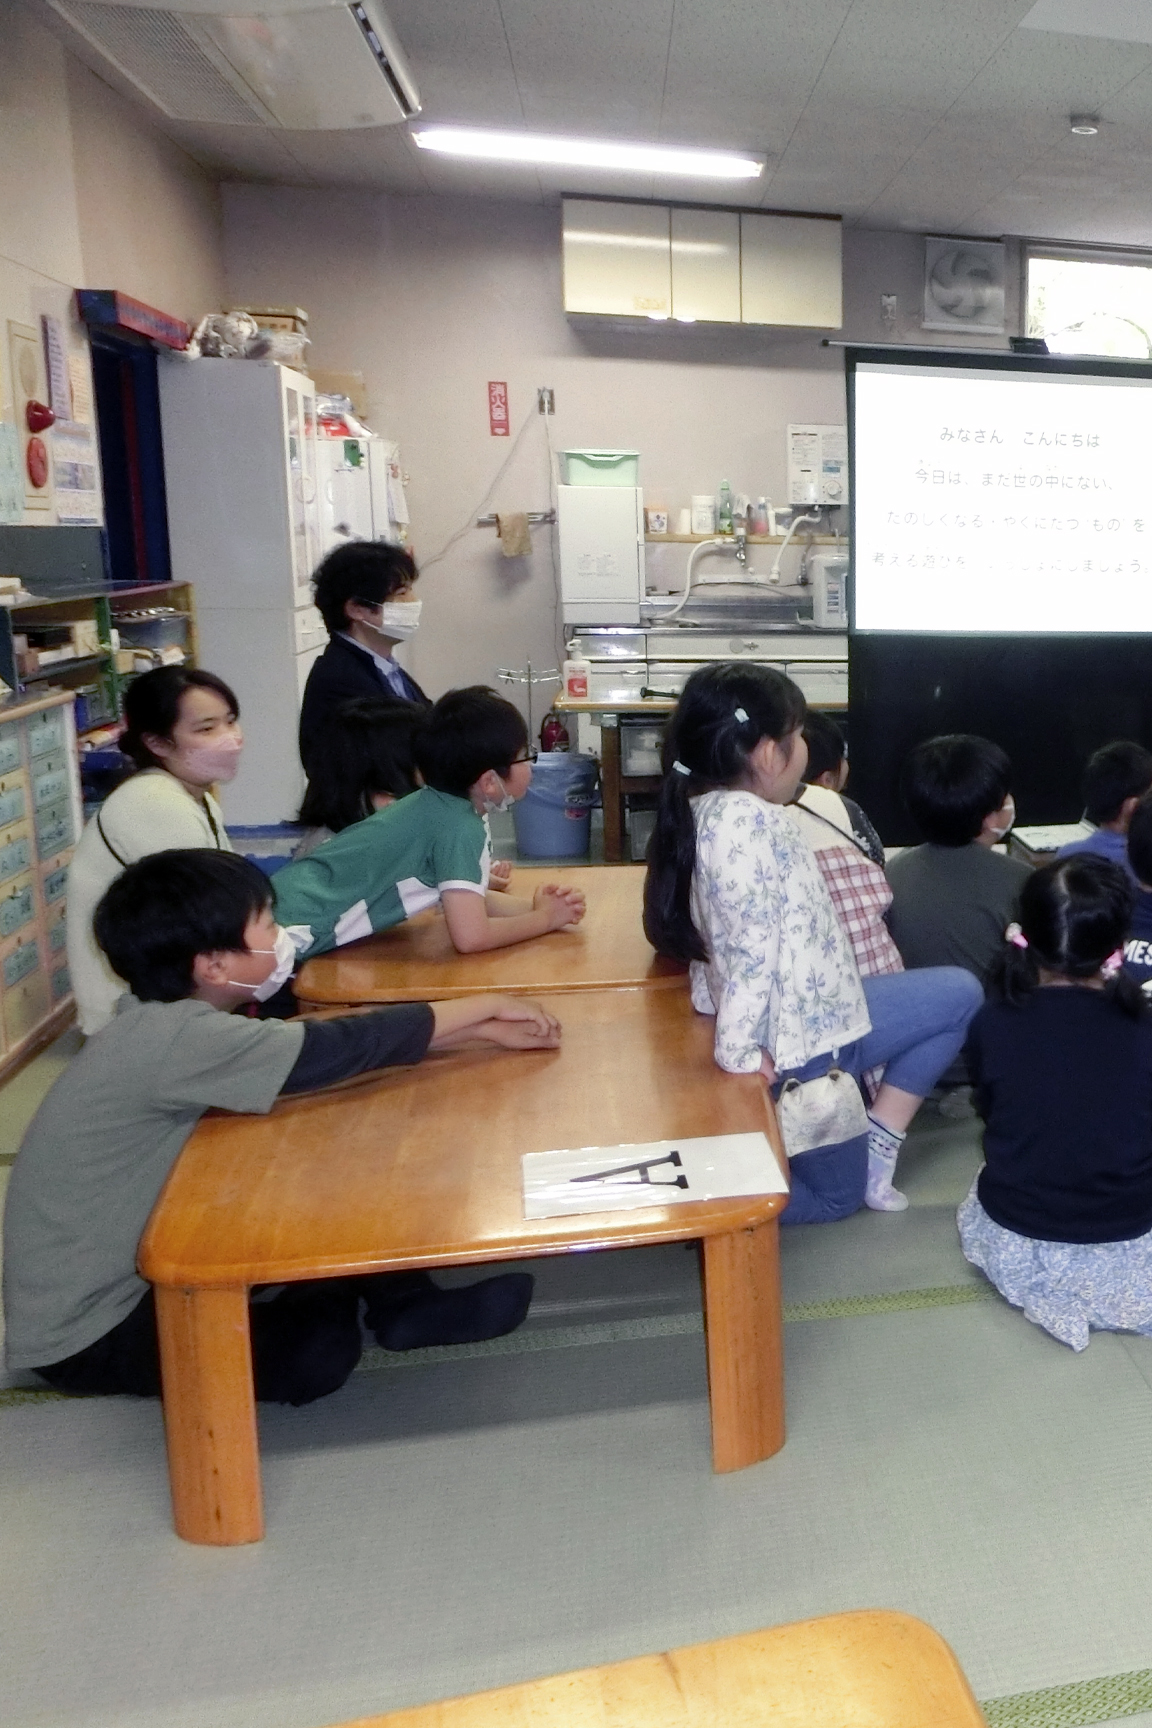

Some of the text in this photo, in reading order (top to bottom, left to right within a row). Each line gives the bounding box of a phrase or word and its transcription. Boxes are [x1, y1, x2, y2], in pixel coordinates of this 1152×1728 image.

[939, 426, 1101, 449] みなさん こんにちは
